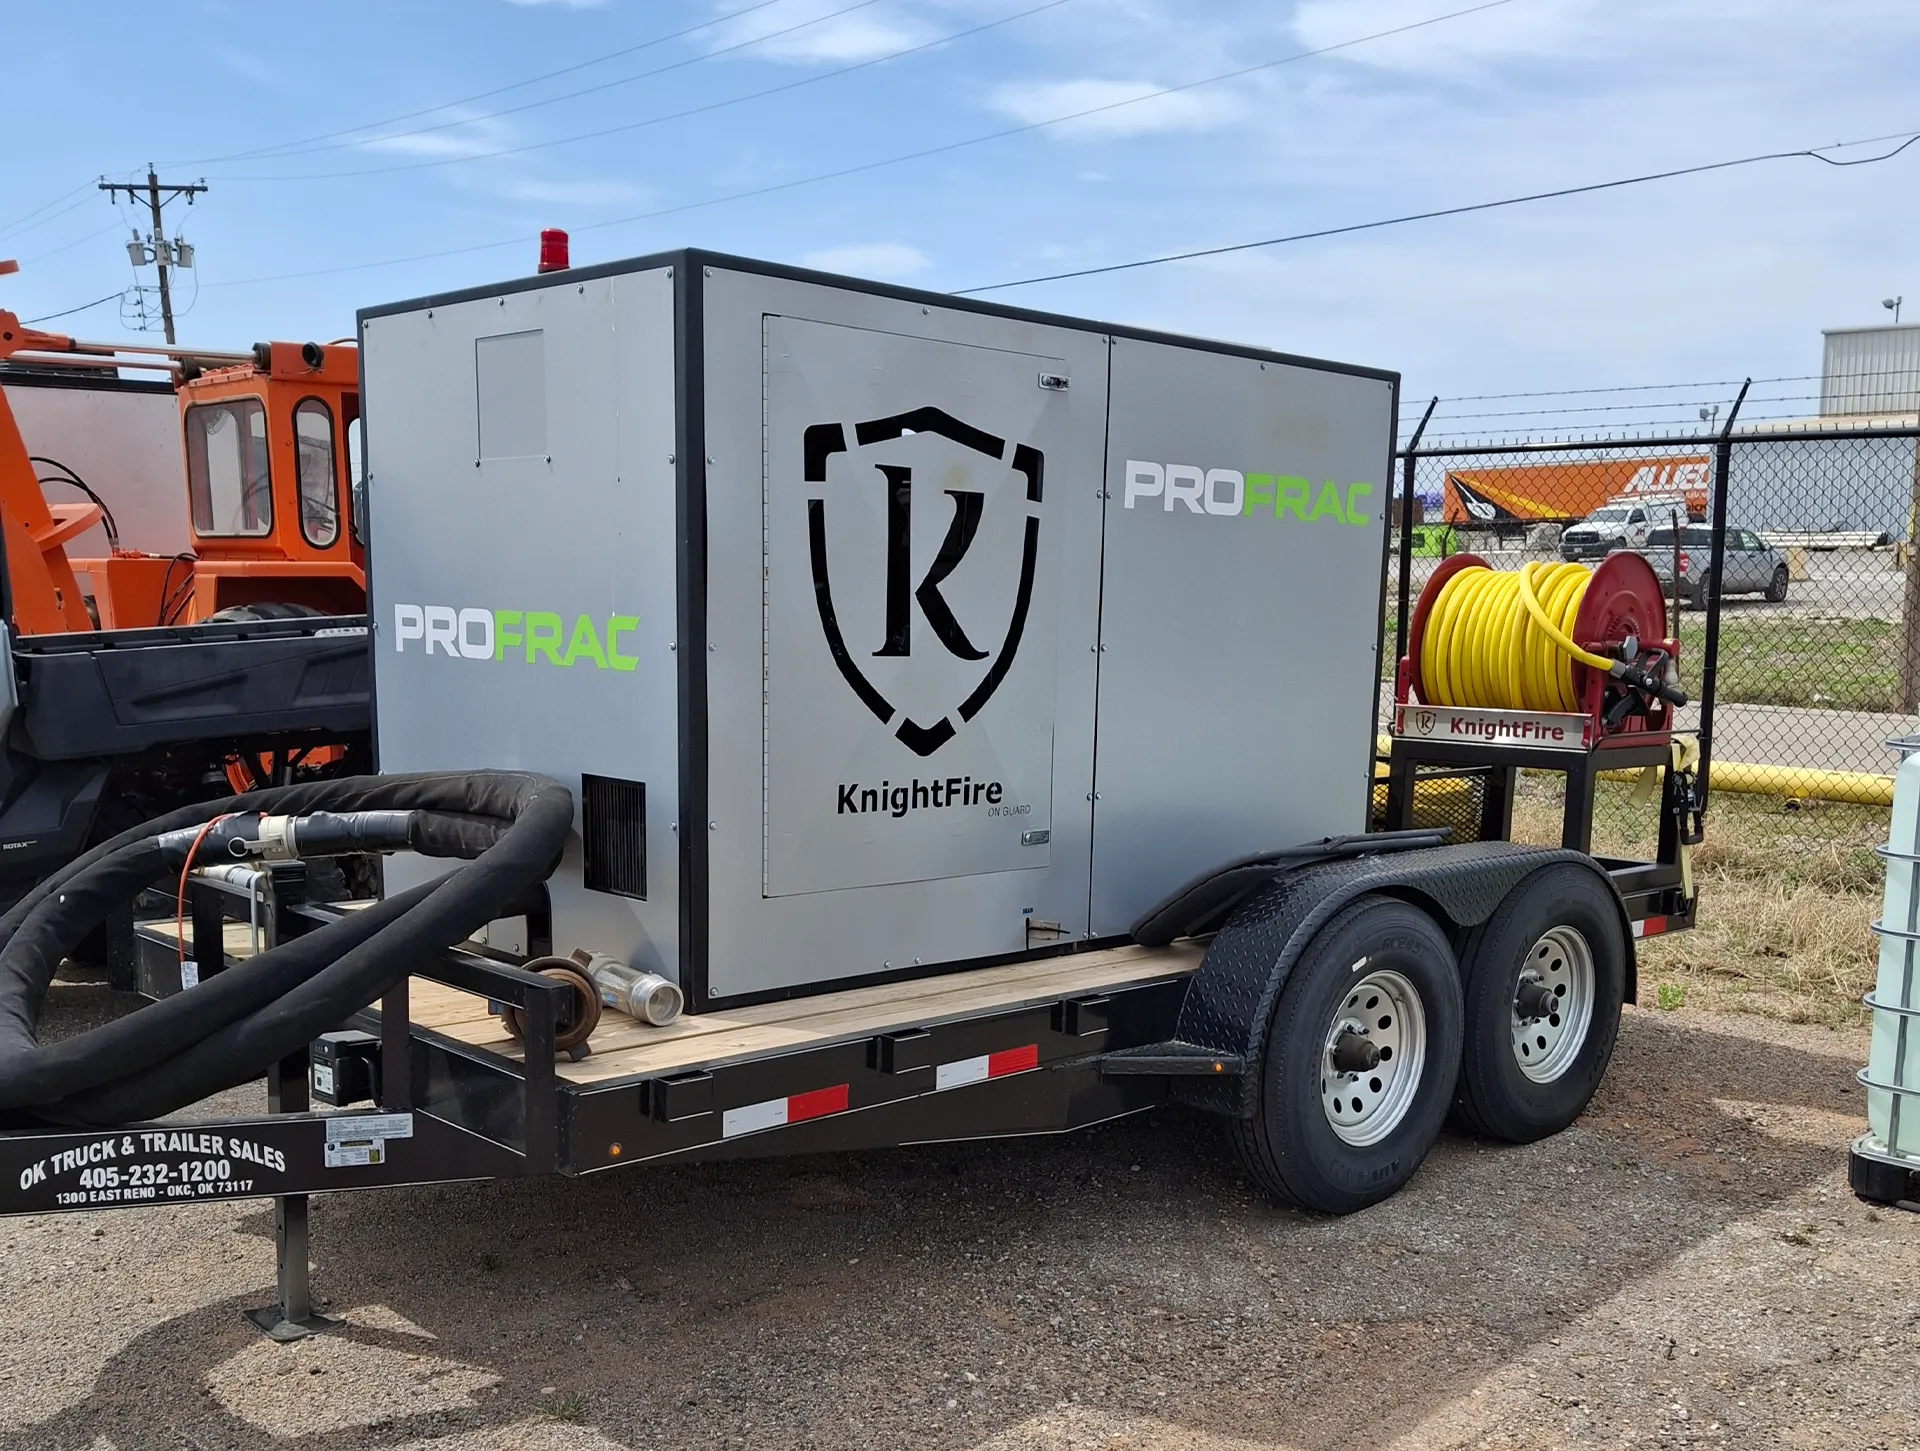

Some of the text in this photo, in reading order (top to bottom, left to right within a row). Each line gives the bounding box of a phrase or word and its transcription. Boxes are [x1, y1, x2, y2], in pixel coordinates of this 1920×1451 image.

[1124, 459, 1373, 527] PROFRAC
[872, 464, 989, 661] K
[394, 603, 640, 671] PROFRAC
[1450, 717, 1564, 741] KnightFire
[837, 776, 1003, 818] KnightFire
[988, 804, 1031, 818] ON GUARD
[3, 841, 30, 850] ROTAX
[20, 1132, 286, 1191] OK TRUCK & TRAILER SALES
[79, 1159, 231, 1189] 405-232-1200
[56, 1191, 87, 1205] 1300
[89, 1189, 121, 1202] EAST
[123, 1186, 155, 1199] RENO
[167, 1184, 195, 1197] OKC,
[197, 1182, 214, 1194] OK
[216, 1180, 253, 1193] 73117
